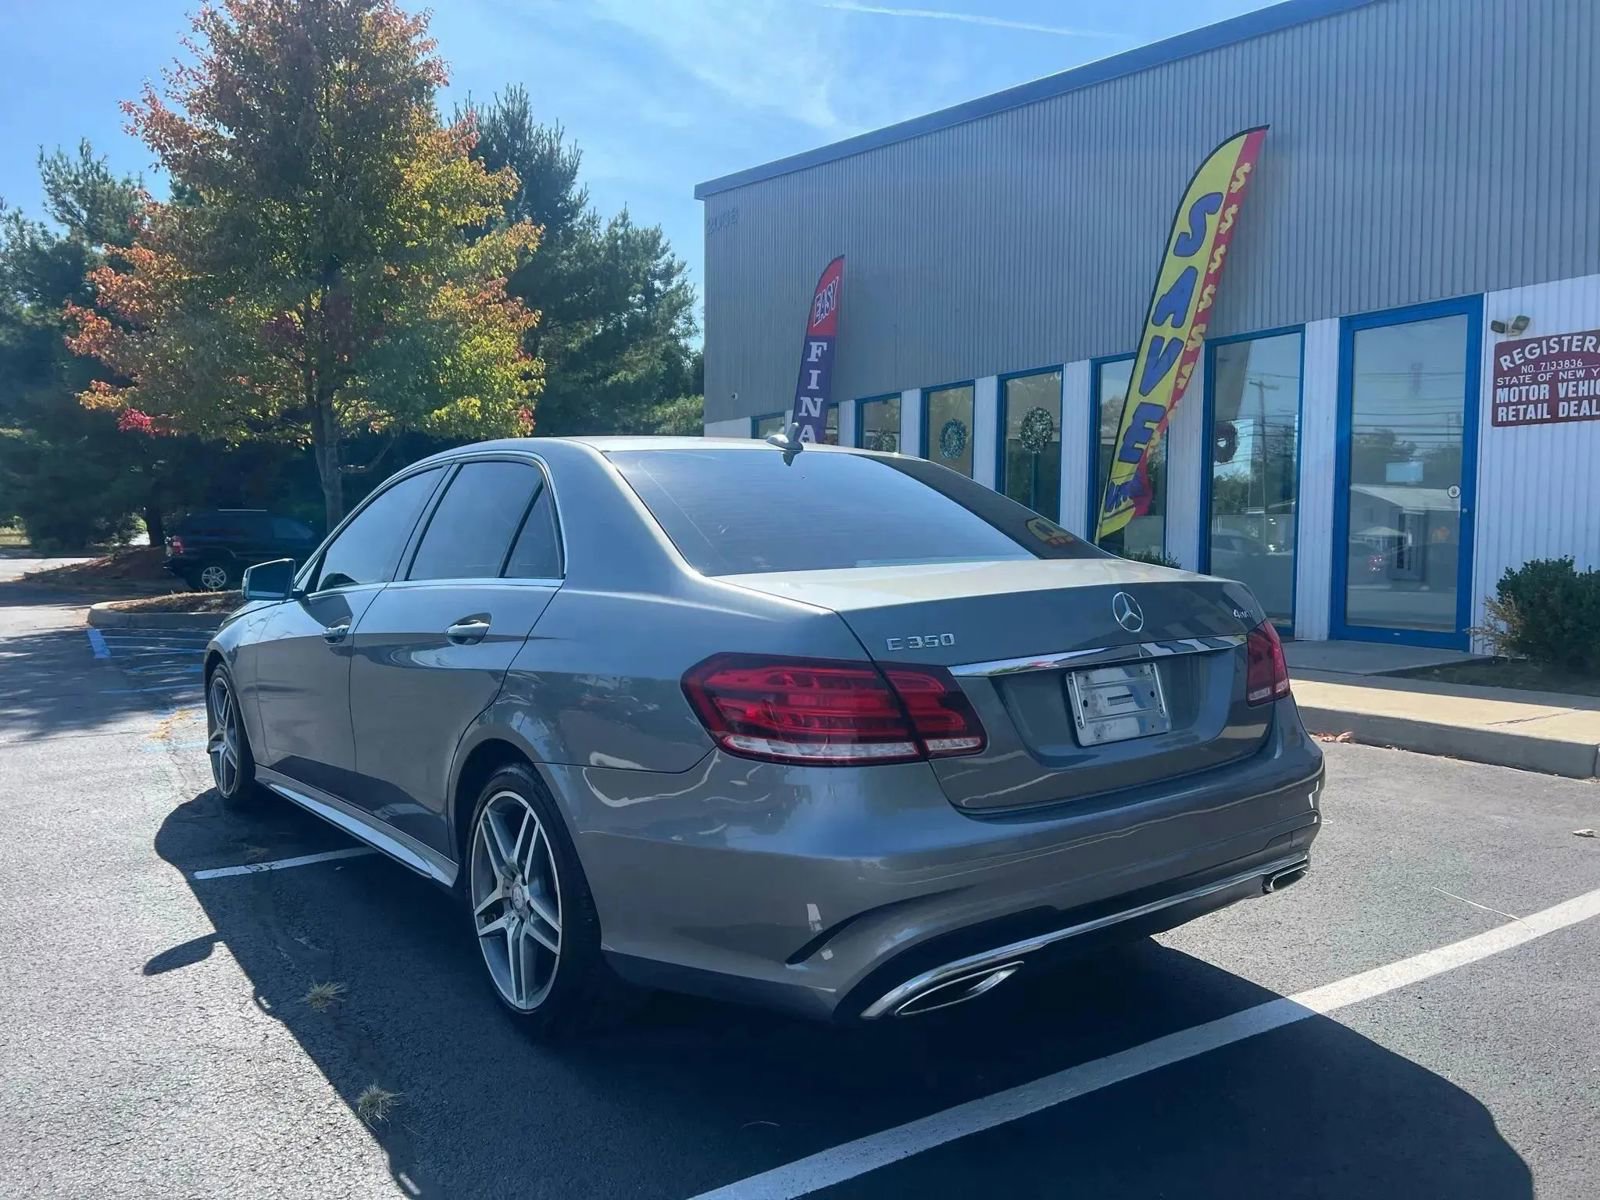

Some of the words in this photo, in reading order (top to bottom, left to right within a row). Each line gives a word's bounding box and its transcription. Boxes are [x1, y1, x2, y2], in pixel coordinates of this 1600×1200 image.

[813, 276, 839, 327] EASY
[1117, 191, 1224, 464] SAVE
[1499, 335, 1600, 371] REGISTER
[1521, 364, 1536, 374] NO.
[1540, 358, 1583, 371] 7133836
[1497, 374, 1533, 386] STATE
[1537, 372, 1554, 382] OF
[1559, 369, 1586, 379] NEW
[1496, 383, 1550, 404] MOTOR
[1497, 403, 1551, 422] RETAIL
[886, 637, 904, 651] E
[907, 633, 955, 649] 350
